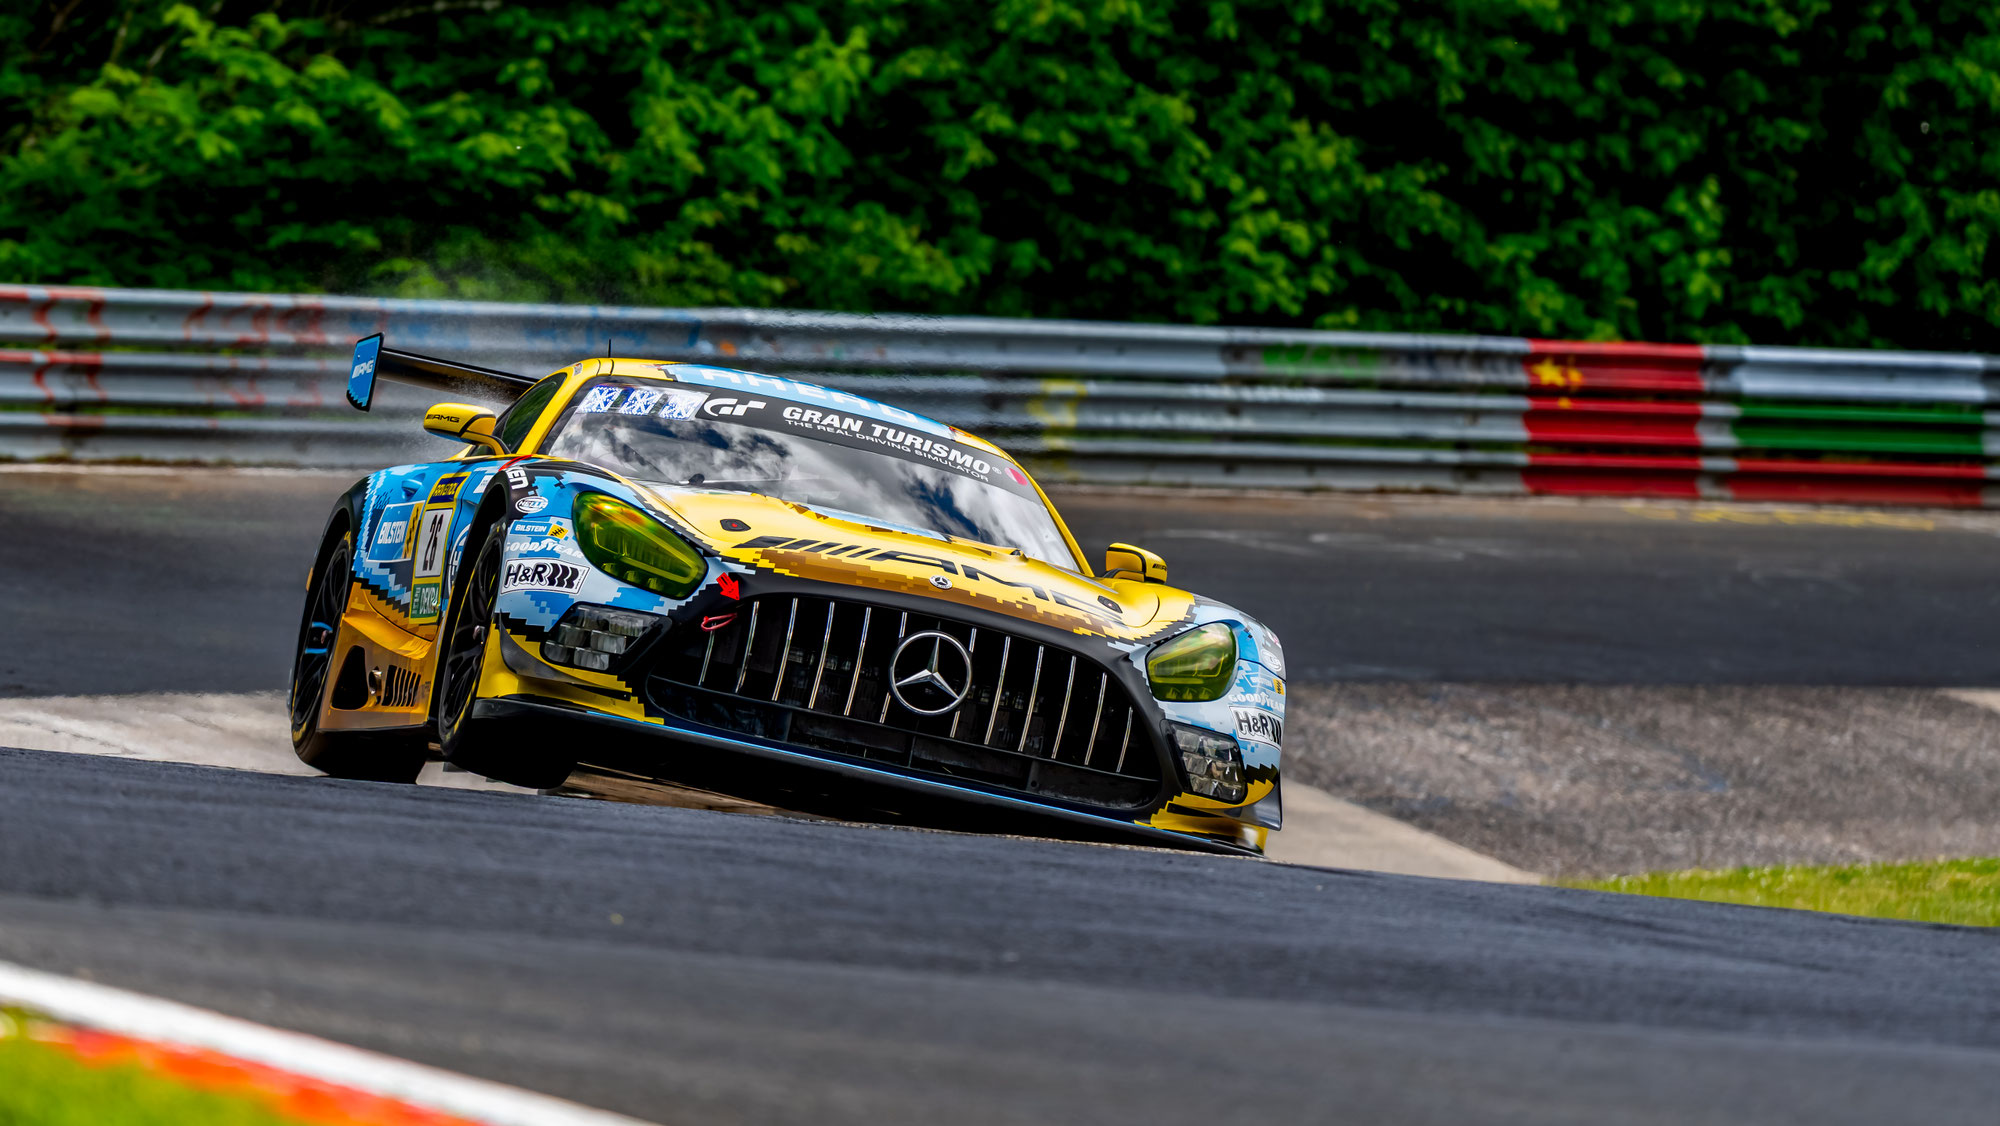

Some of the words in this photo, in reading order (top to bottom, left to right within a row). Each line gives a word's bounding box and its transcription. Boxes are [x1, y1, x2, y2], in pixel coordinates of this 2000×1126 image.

[356, 360, 374, 377] AMG
[431, 414, 460, 423] AMG
[783, 406, 863, 432] GRAN
[785, 419, 808, 428] THE
[816, 425, 853, 437] REAL
[856, 433, 911, 454] DRIVING
[913, 450, 989, 483] SIMULATOR
[377, 521, 408, 545] BILSTEIN
[514, 524, 547, 532] BILSTEIN
[422, 514, 443, 572] 26
[504, 563, 548, 587] H&R
[1235, 711, 1269, 736] H&R
